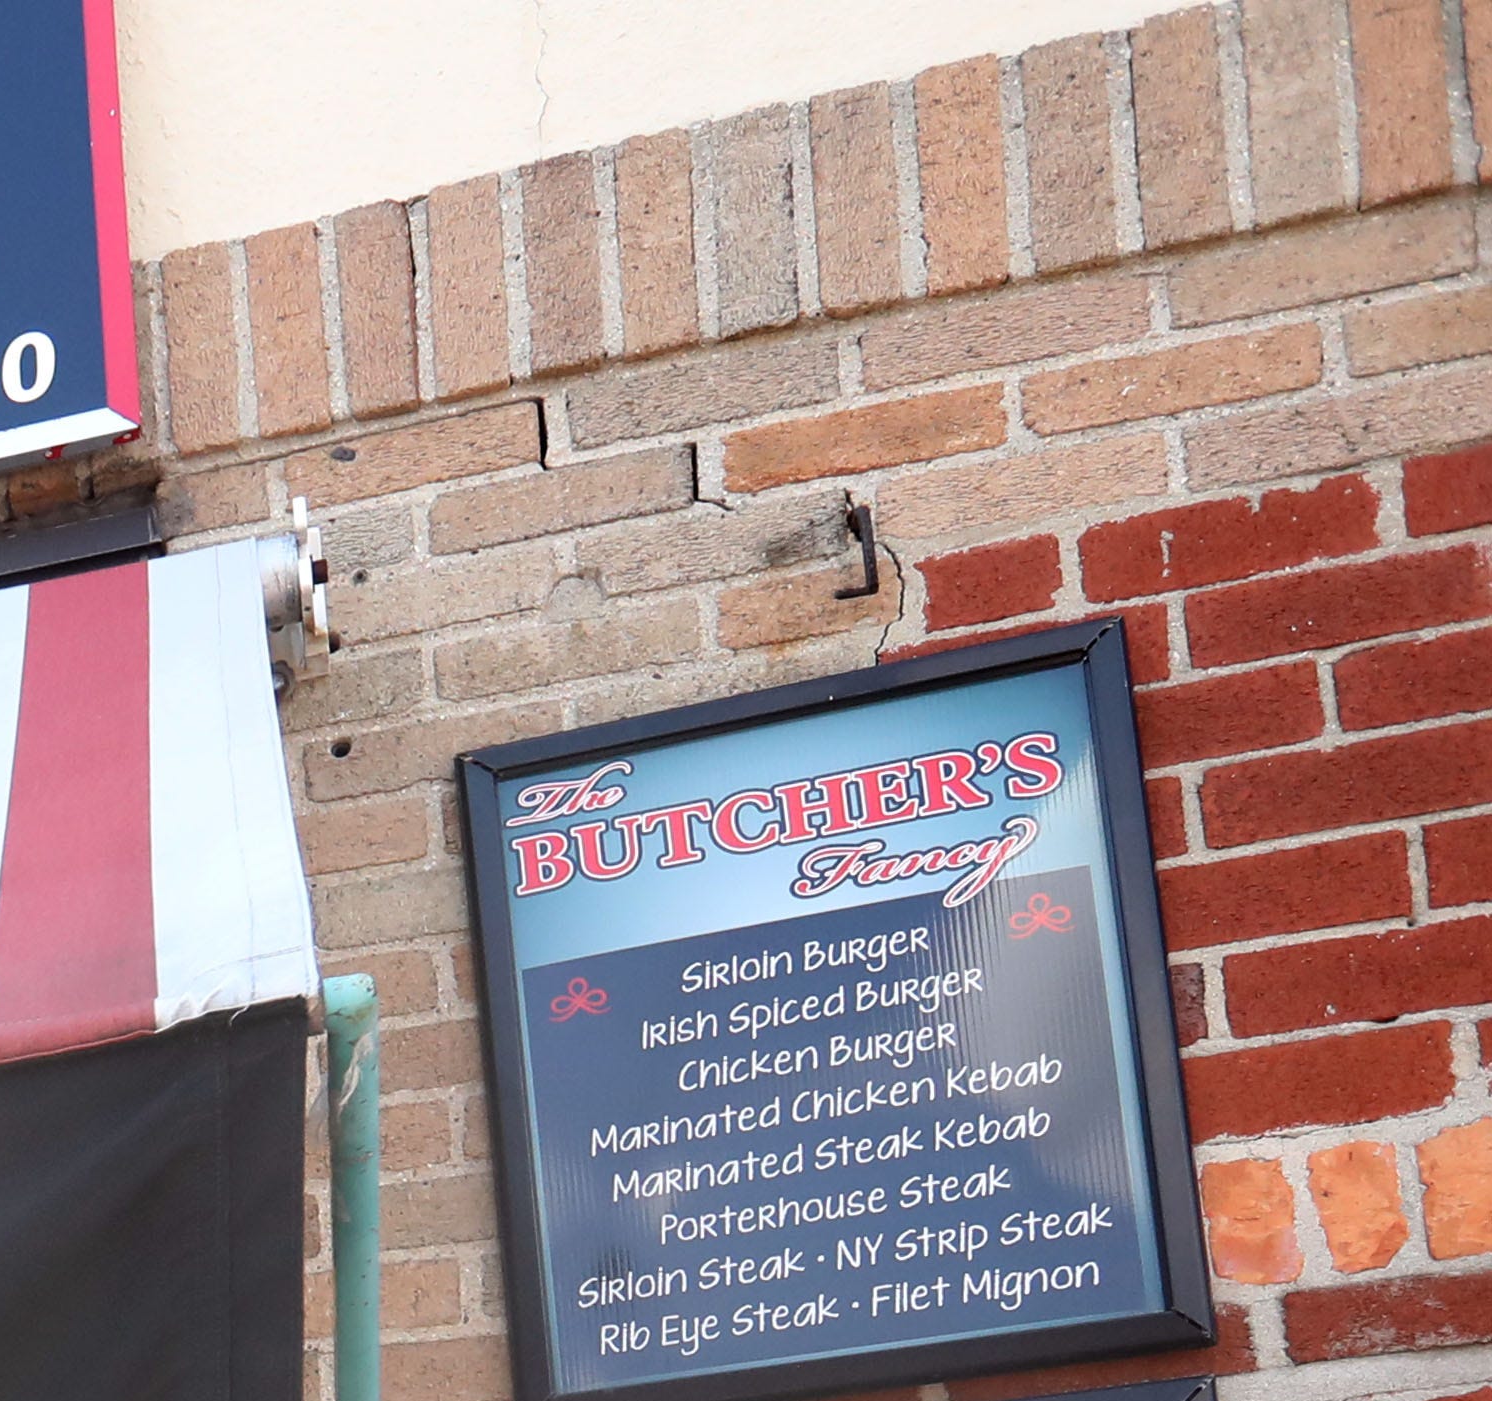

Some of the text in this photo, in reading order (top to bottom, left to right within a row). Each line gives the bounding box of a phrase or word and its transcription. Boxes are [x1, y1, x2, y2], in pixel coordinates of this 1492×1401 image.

[506, 760, 631, 828] The
[513, 731, 1064, 897] BUTCHER'S
[791, 816, 1037, 908] Fancy
[728, 988, 845, 1039] Spiced
[678, 1049, 819, 1091] Chicken
[791, 1078, 935, 1124] Chicken
[946, 1053, 1063, 1098] Kebab
[814, 1134, 924, 1171] Steak
[933, 1106, 1051, 1154] Kebab
[900, 1164, 1011, 1206] Steak
[699, 1249, 805, 1291] Steak
[836, 1239, 884, 1269] NY
[1000, 1203, 1113, 1245] Steak
[600, 1259, 1100, 1356] Rib Eye Steak Filet Mignon
